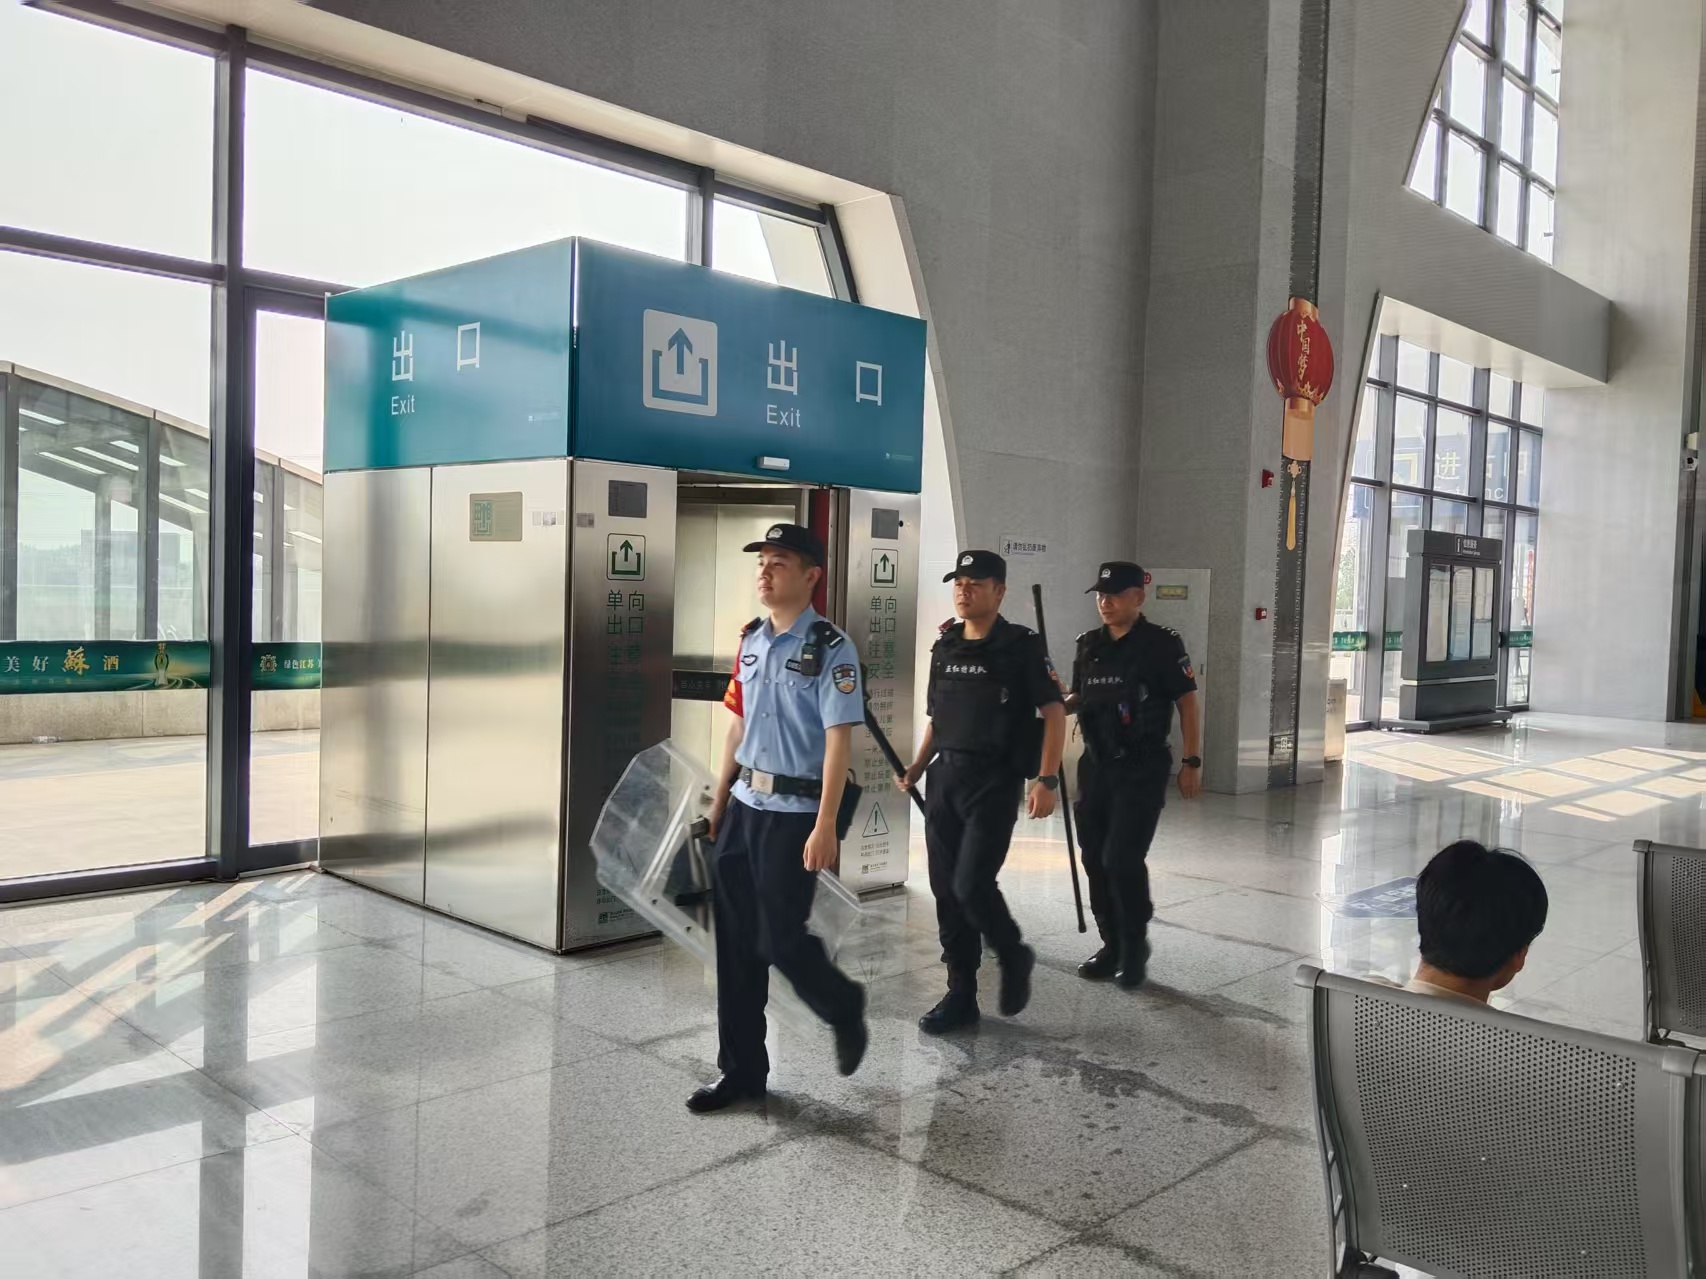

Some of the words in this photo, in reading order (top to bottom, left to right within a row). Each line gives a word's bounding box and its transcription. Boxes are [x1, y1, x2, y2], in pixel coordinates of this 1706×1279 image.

[391, 322, 481, 381] 出口
[767, 340, 883, 406] 出口
[391, 395, 415, 415] Exit
[766, 404, 800, 427] Exit
[606, 589, 645, 611] 单向
[869, 596, 897, 614] 单向
[607, 614, 643, 634] 出口
[869, 616, 896, 633] 出口
[867, 662, 895, 679] 安全
